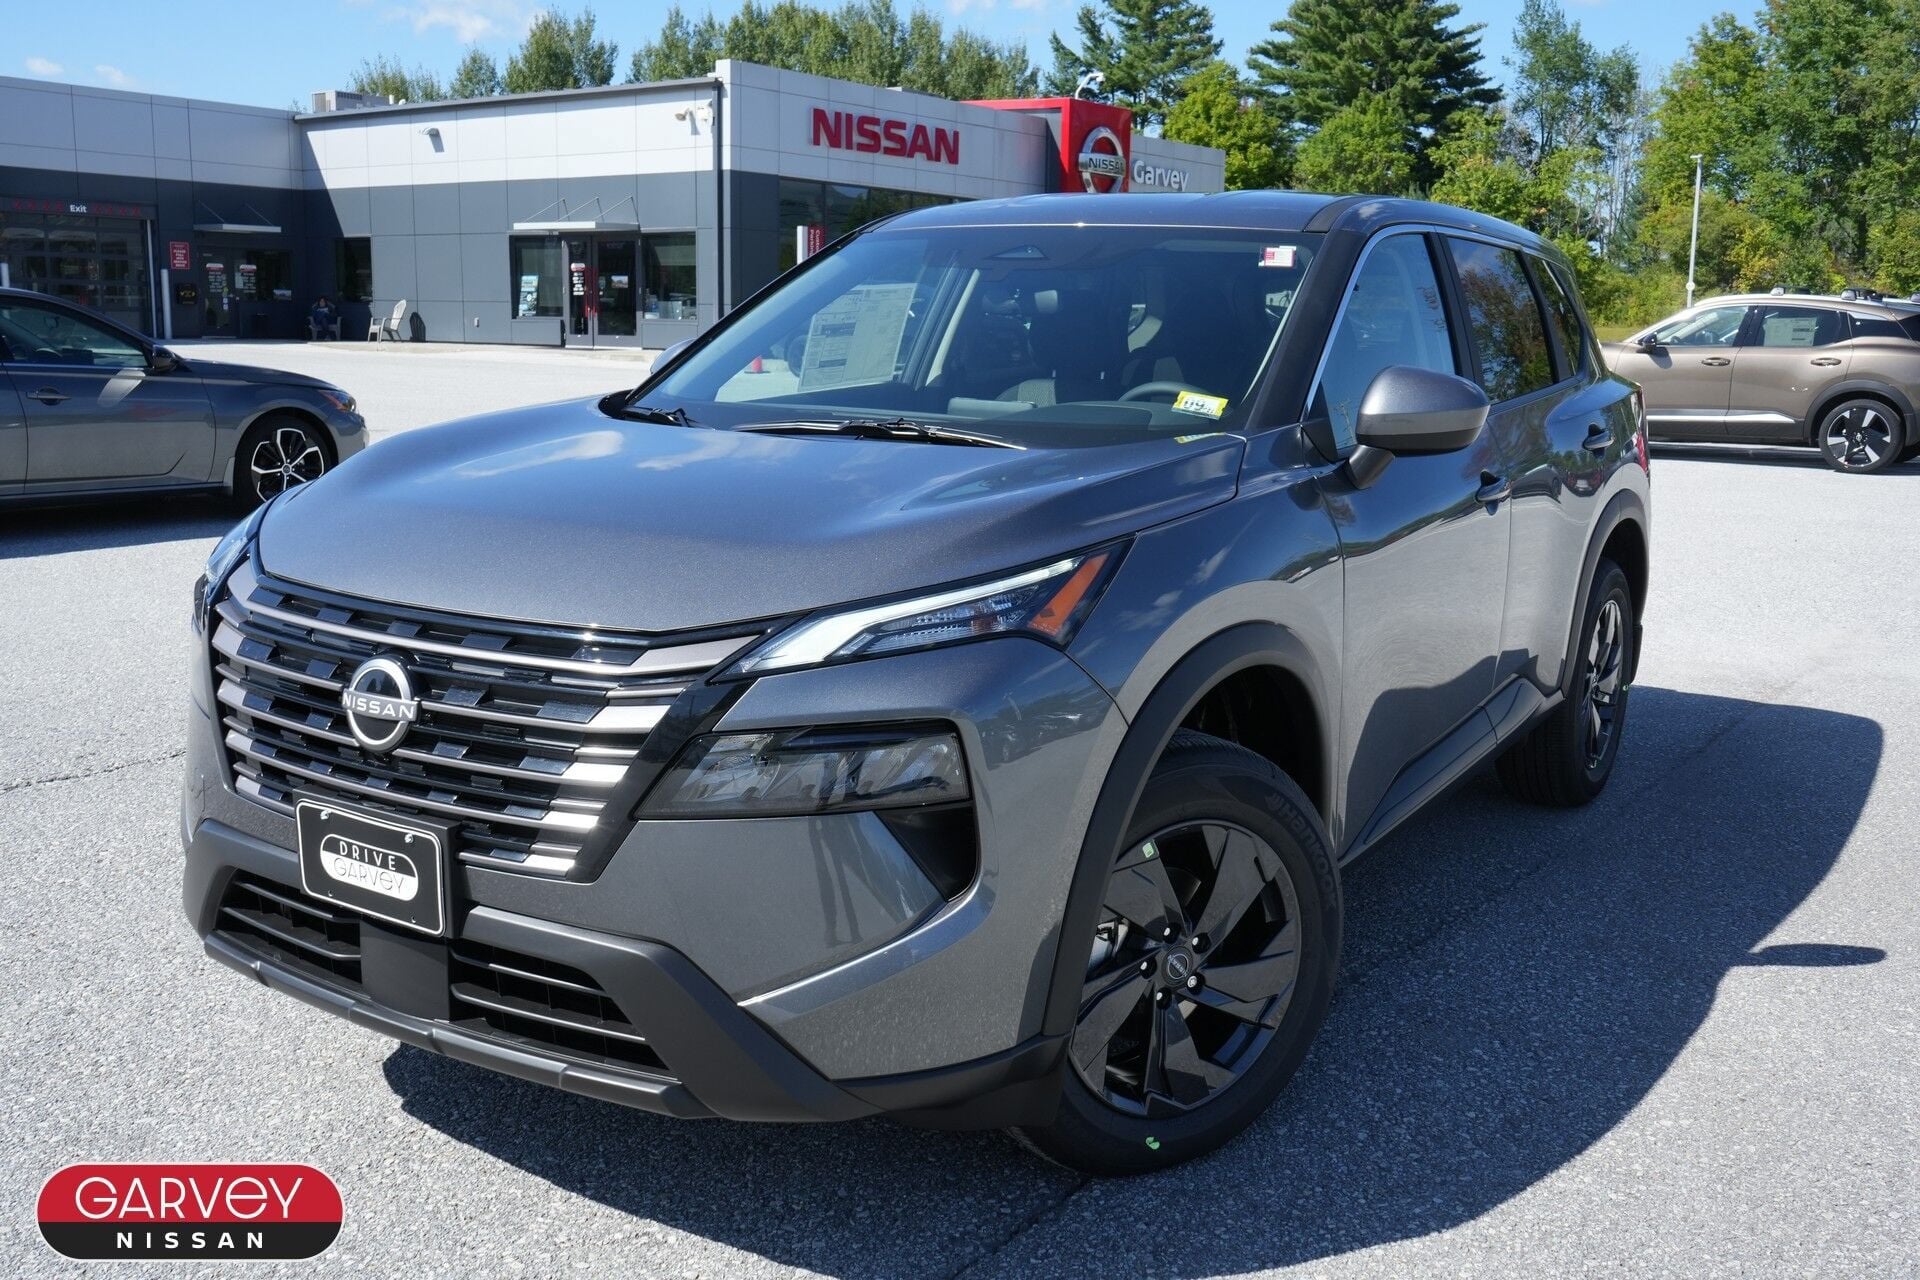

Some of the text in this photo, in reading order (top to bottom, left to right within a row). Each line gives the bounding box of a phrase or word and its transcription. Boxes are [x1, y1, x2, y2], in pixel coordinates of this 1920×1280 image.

[812, 107, 960, 165] NISSAN
[1132, 159, 1190, 192] Garvey
[69, 204, 87, 213] Exit
[342, 692, 417, 720] NISSAN
[339, 840, 397, 871] DRIVE
